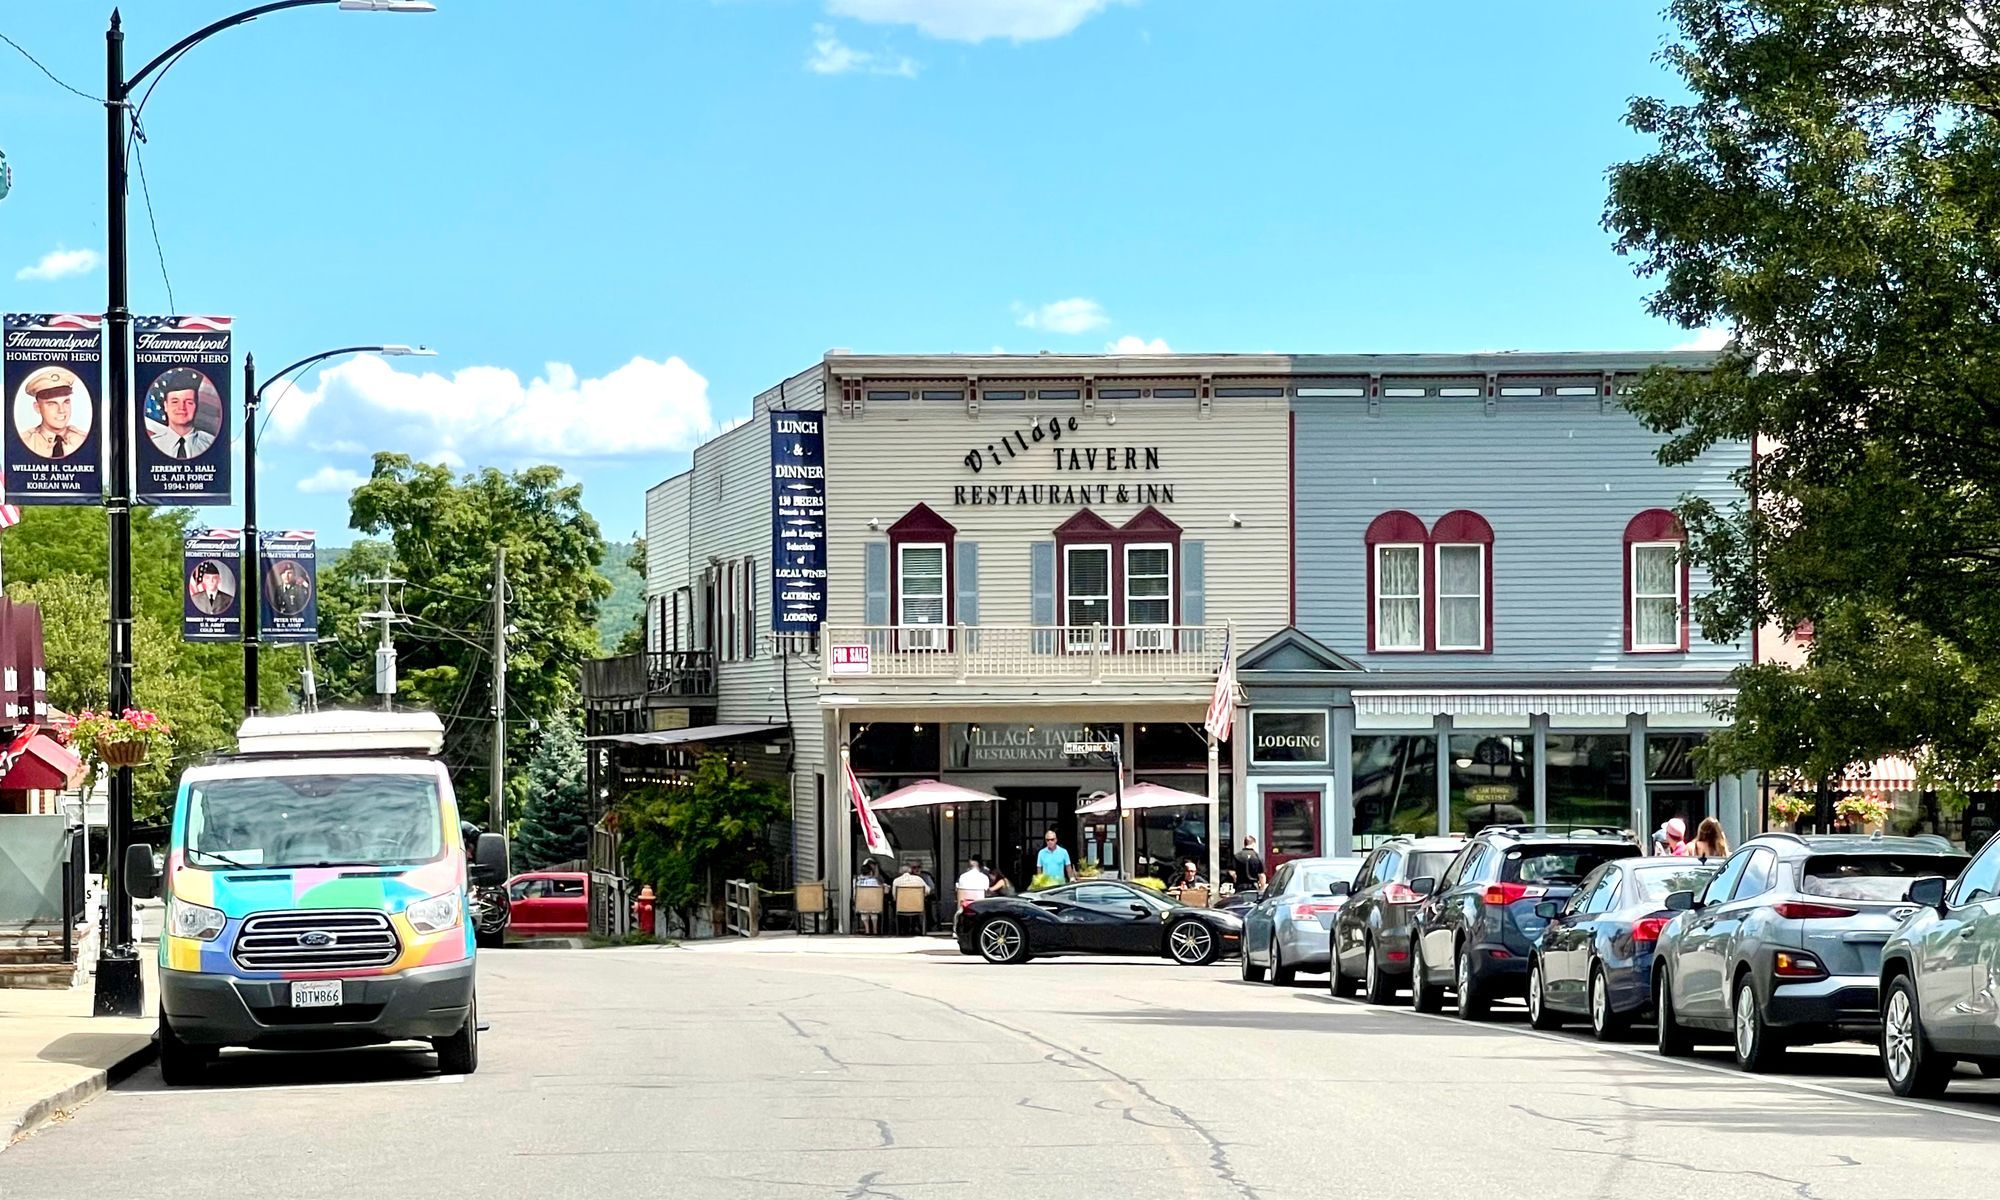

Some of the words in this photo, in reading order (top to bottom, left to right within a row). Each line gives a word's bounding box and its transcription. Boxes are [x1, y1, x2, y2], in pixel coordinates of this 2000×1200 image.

[6, 332, 98, 350] Hammondsport
[136, 333, 228, 353] Hammondsport
[6, 353, 67, 361] HOMETOWN
[71, 353, 99, 361] HERO
[136, 354, 197, 363] HOMETOWN
[200, 354, 229, 363] HERO
[777, 420, 818, 434] LUNCH
[793, 443, 803, 456] &
[964, 416, 1079, 473] Village
[1053, 447, 1160, 471] TAVERN
[12, 464, 49, 472] WILLIAM
[51, 464, 61, 472] H.
[62, 464, 95, 472] CLARKE
[150, 465, 182, 473] JEREMY
[195, 465, 216, 473] HALL
[775, 464, 824, 479] DINNER
[32, 473, 48, 481] U.S.
[50, 473, 75, 481] ARMY
[153, 473, 169, 481] U.S.
[171, 473, 185, 481] AIR
[187, 473, 214, 481] FORCE
[27, 482, 61, 490] KOREAN
[63, 482, 80, 490] WAR
[954, 485, 1109, 505] RESTAURANT
[1116, 484, 1130, 503] &
[1137, 484, 1174, 503] INN
[793, 496, 824, 507] BEERS
[776, 569, 801, 578] LOCAL
[801, 569, 827, 578] WINES
[781, 592, 821, 601] CATERING
[783, 613, 817, 622] LODGING
[833, 648, 847, 663] FOR
[850, 648, 868, 662] SALE
[963, 730, 1036, 746] VILLAGE
[1042, 730, 1110, 746] TAVERN
[1258, 735, 1320, 747] LODGING
[975, 748, 1056, 760] RESTAURANT
[306, 935, 327, 945] Ford
[295, 990, 339, 1003] 8DTW866
